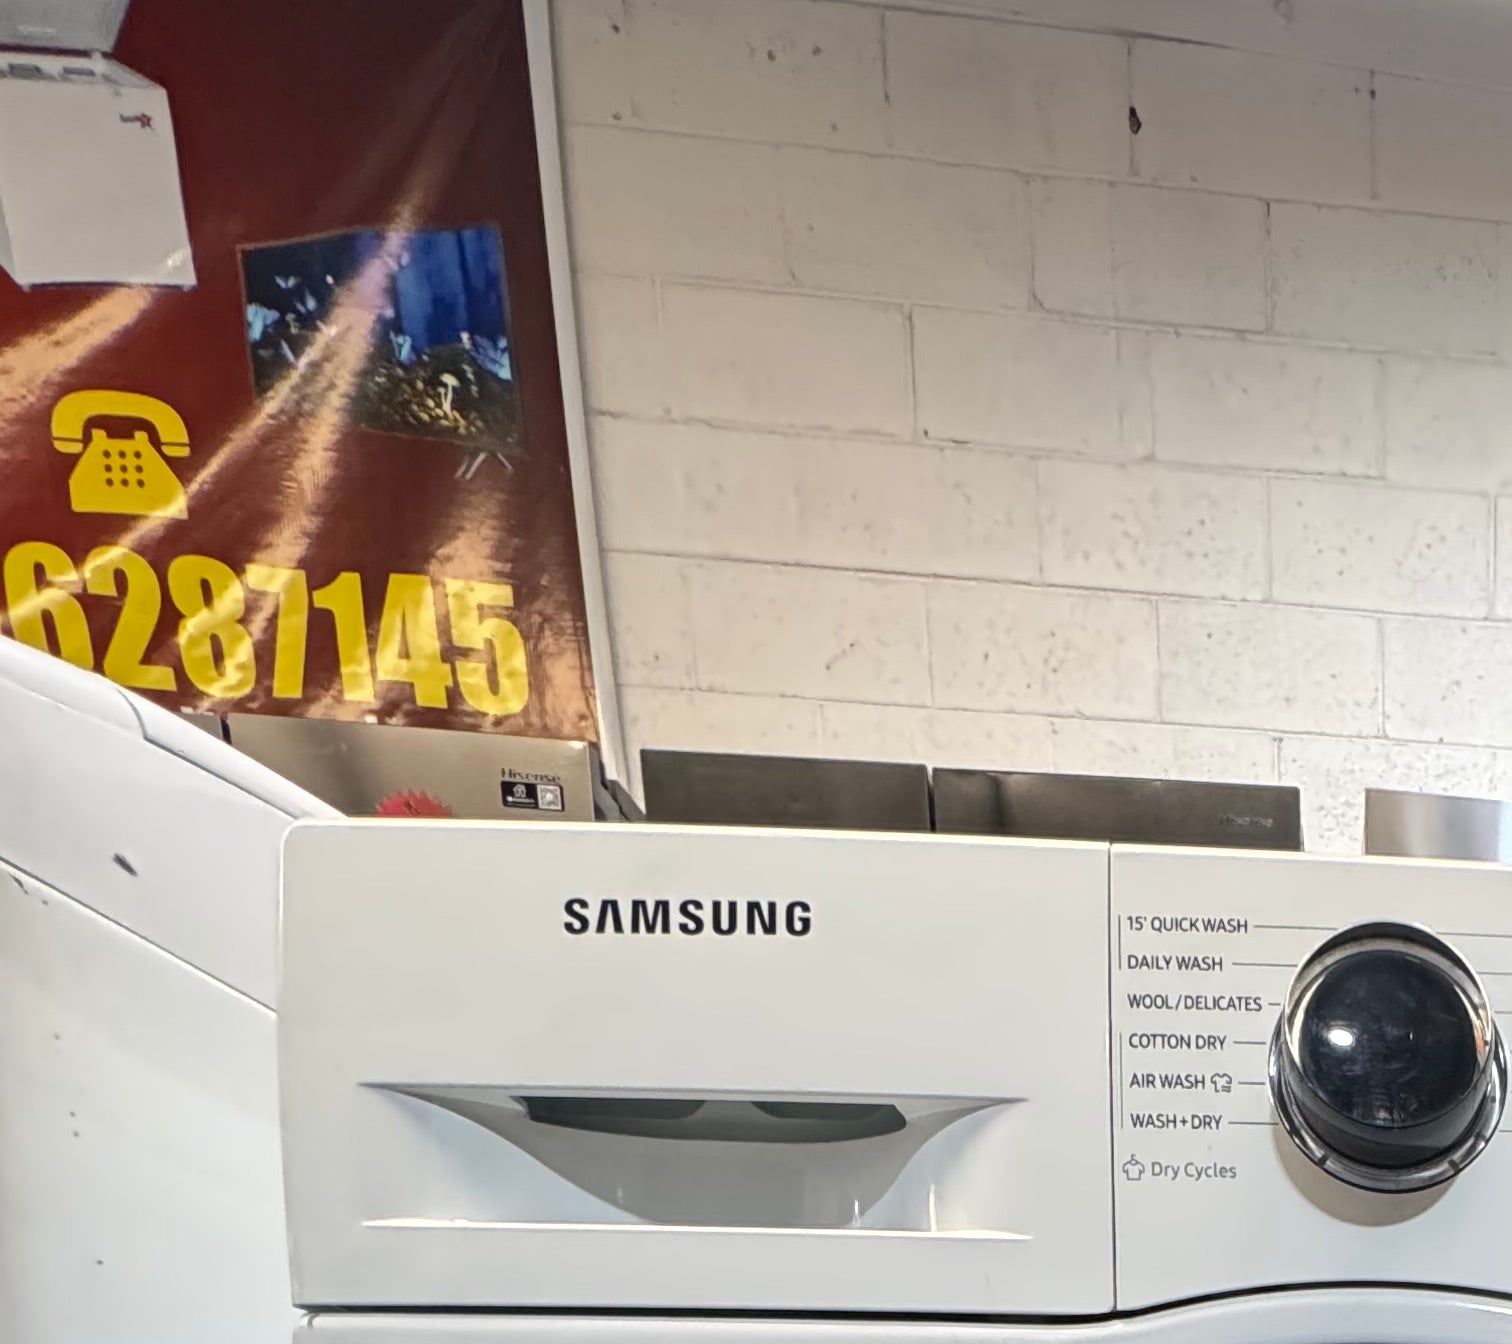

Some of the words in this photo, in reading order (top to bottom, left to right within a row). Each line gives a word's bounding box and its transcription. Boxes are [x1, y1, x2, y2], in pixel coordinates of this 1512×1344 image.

[3, 541, 530, 717] 6287145
[563, 896, 812, 937] SAMSUNG
[1150, 915, 1200, 934] QUICK
[1202, 917, 1248, 934] WASH
[1127, 954, 1172, 970] DAILY
[1176, 955, 1223, 971] WASH
[1128, 1032, 1192, 1050] COTTON
[1195, 1034, 1227, 1050] DRY
[1129, 1072, 1156, 1089] AIR
[1158, 1073, 1206, 1090] WASH
[1151, 1161, 1180, 1181] Dry
[1184, 1161, 1237, 1182] Cycles
